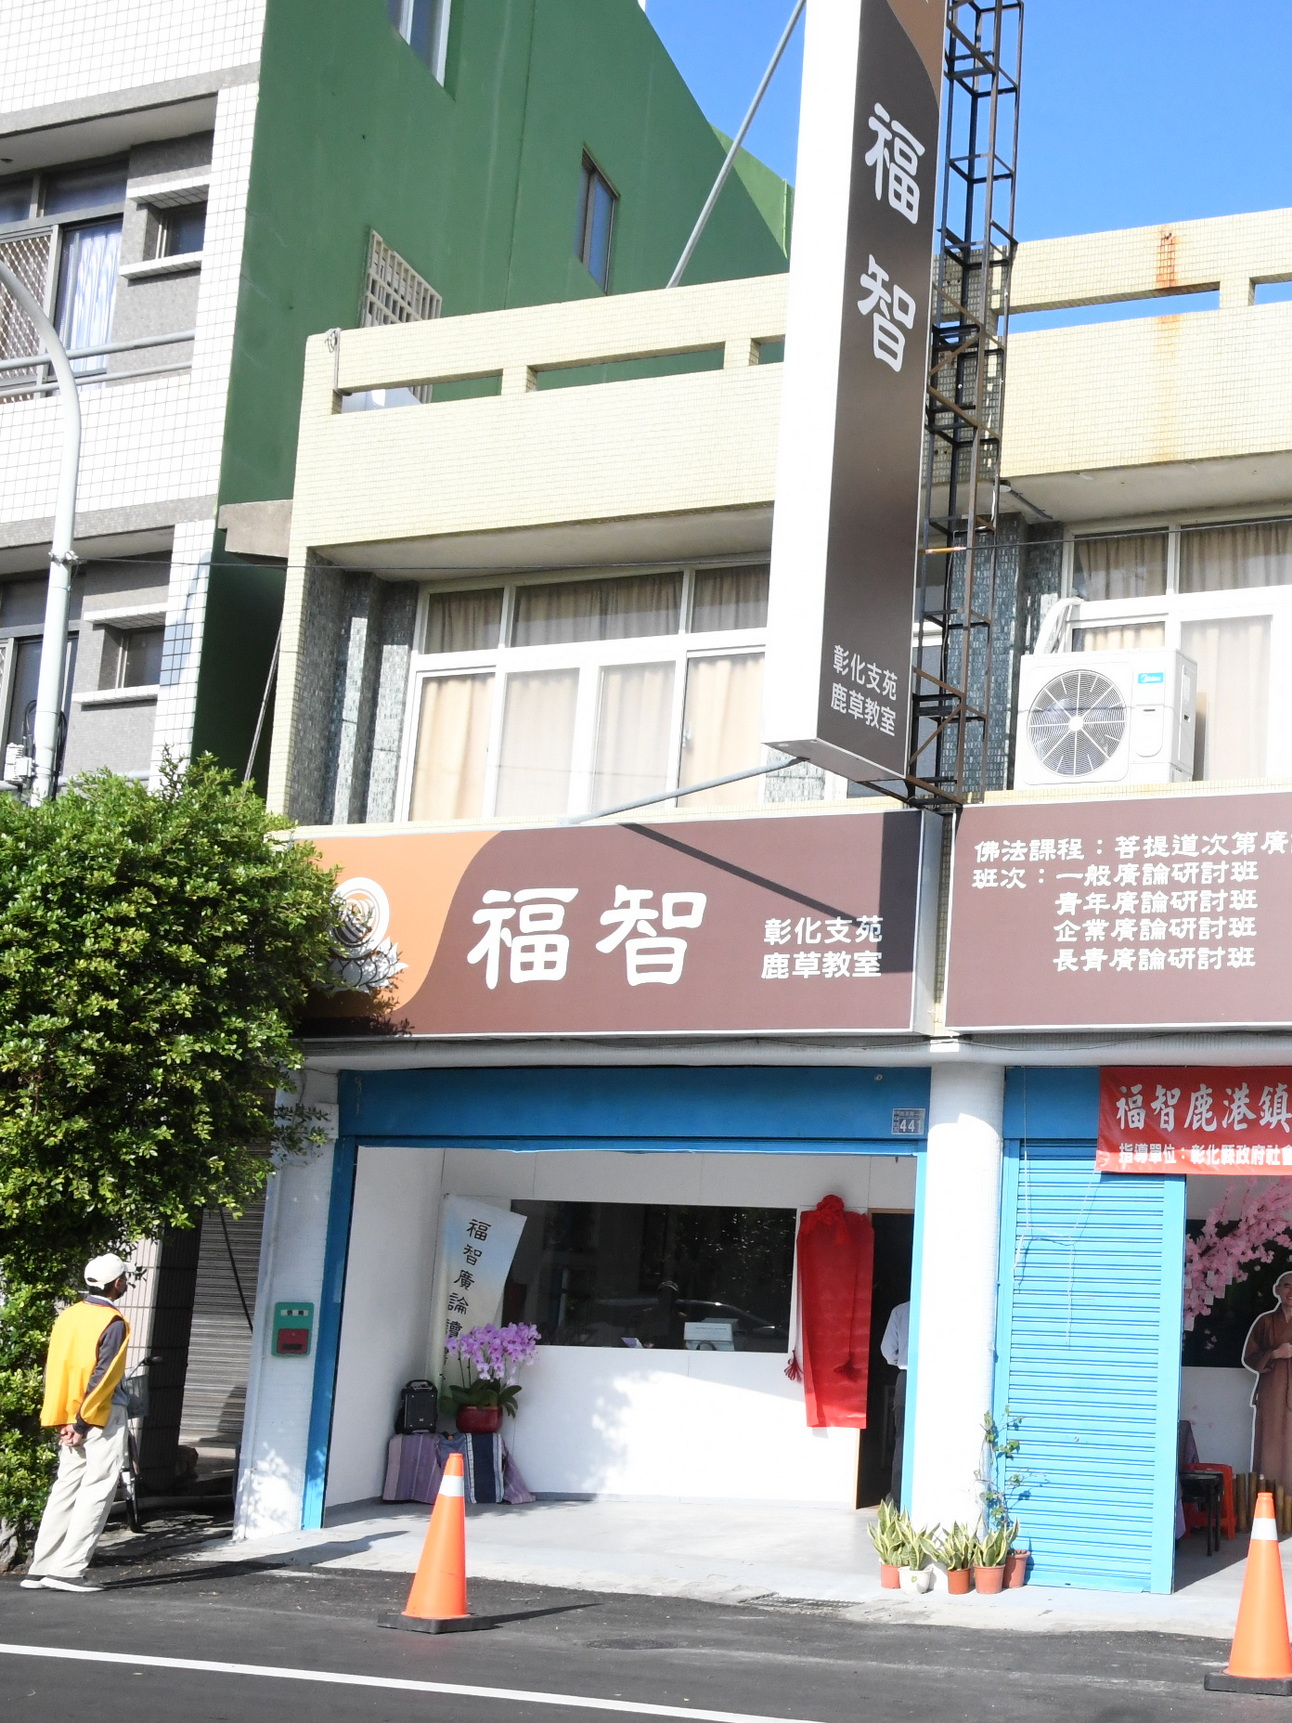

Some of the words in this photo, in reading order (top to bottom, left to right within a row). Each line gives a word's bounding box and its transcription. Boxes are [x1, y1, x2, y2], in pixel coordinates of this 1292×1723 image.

[857, 102, 926, 373] 福智
[833, 644, 898, 701] 彰化支苑
[831, 682, 896, 736] 鹿草教室
[971, 860, 1260, 889] 班次：一般廣論研討班
[1054, 888, 1259, 916] 青年廣論研討班
[467, 885, 707, 990] 福智
[763, 915, 884, 946] 彰化支苑
[1053, 916, 1257, 943] 企業廣論研討班
[760, 950, 882, 980] 鹿草教室
[1053, 946, 1256, 972] 長青廣論研討班
[900, 1119, 922, 1133] 441
[440, 1219, 492, 1380] 福智廣論讀
